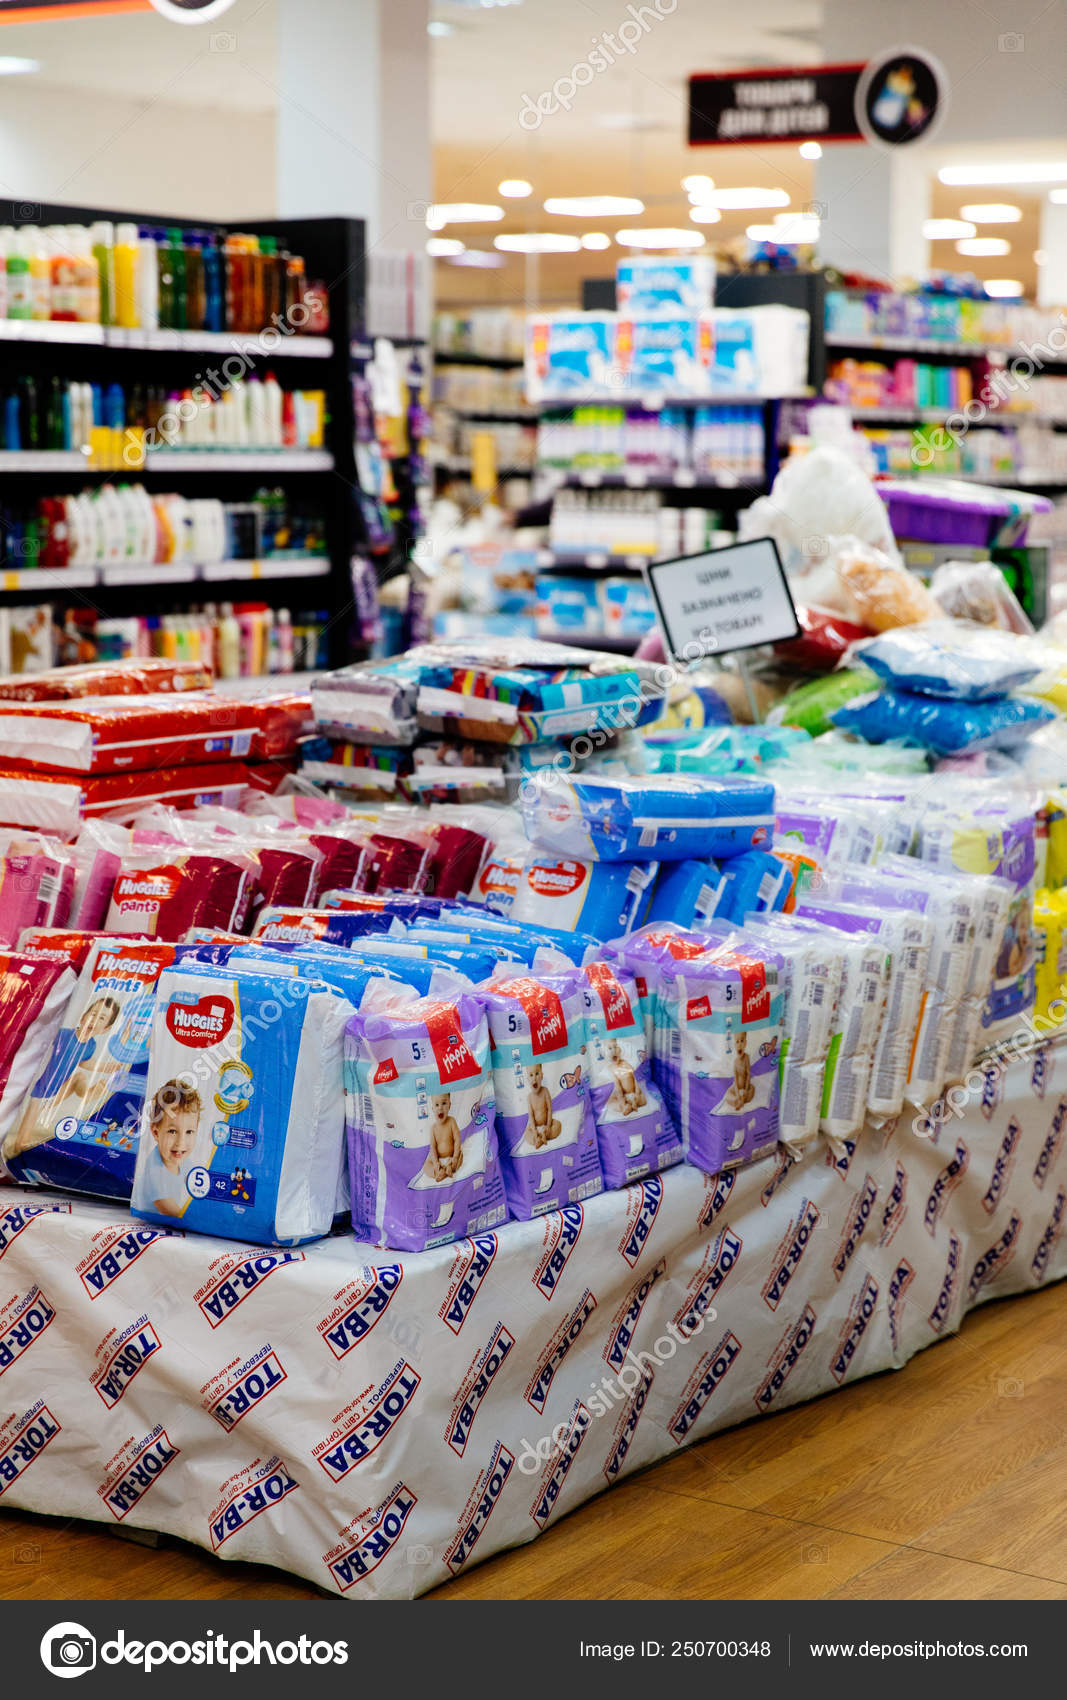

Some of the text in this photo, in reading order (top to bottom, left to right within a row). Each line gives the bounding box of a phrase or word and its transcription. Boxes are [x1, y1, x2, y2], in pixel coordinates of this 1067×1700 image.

[118, 879, 170, 896] HUGGIES
[120, 900, 158, 916] pants
[97, 954, 160, 976] HUGGIES
[94, 978, 143, 993] pants
[584, 992, 592, 1008] 5
[726, 984, 733, 1001] 5
[174, 1008, 224, 1032] HUGGIES
[176, 1028, 217, 1040] Ultra Comfort
[508, 1014, 517, 1033] 5
[412, 1042, 422, 1061] 5
[63, 1120, 73, 1132] 6
[194, 1172, 226, 1190] 5 42
[217, 1260, 235, 1278] СВІТІ
[768, 1212, 818, 1301] TOR-BA
[193, 1275, 219, 1302] ТОРГІВЛІ
[204, 1252, 300, 1320] TOR-BA
[447, 1233, 495, 1324] TOR-BA
[327, 1264, 401, 1351] TOR-BA
[344, 1289, 362, 1307] СВІТІ
[316, 1305, 344, 1333] ТОРГІВЛІ
[834, 1287, 878, 1374] TOR-BA
[100, 1332, 158, 1401] TOR-BA
[233, 1343, 273, 1380] ПЕРЕВОРОТ
[531, 1303, 594, 1403] TOR-BA
[760, 1316, 815, 1404] TOR-BA
[368, 1357, 405, 1406] ПЕРЕВОРОТ
[452, 1338, 512, 1446] TOR-BA
[674, 1345, 739, 1434] TOR-BA
[323, 1375, 418, 1473] TOR-BA
[342, 1412, 361, 1429] СВІТІ
[131, 1424, 164, 1457] ПЕРЕВОРОТ
[311, 1428, 344, 1457] ТОРГІВЛІ
[109, 1441, 176, 1512] TOR-BA
[212, 1469, 298, 1542] TOR-BA
[367, 1481, 404, 1526] ПЕРЕВОРОТ
[451, 1456, 513, 1564] TOR-BA
[333, 1497, 413, 1584] TOR-BA
